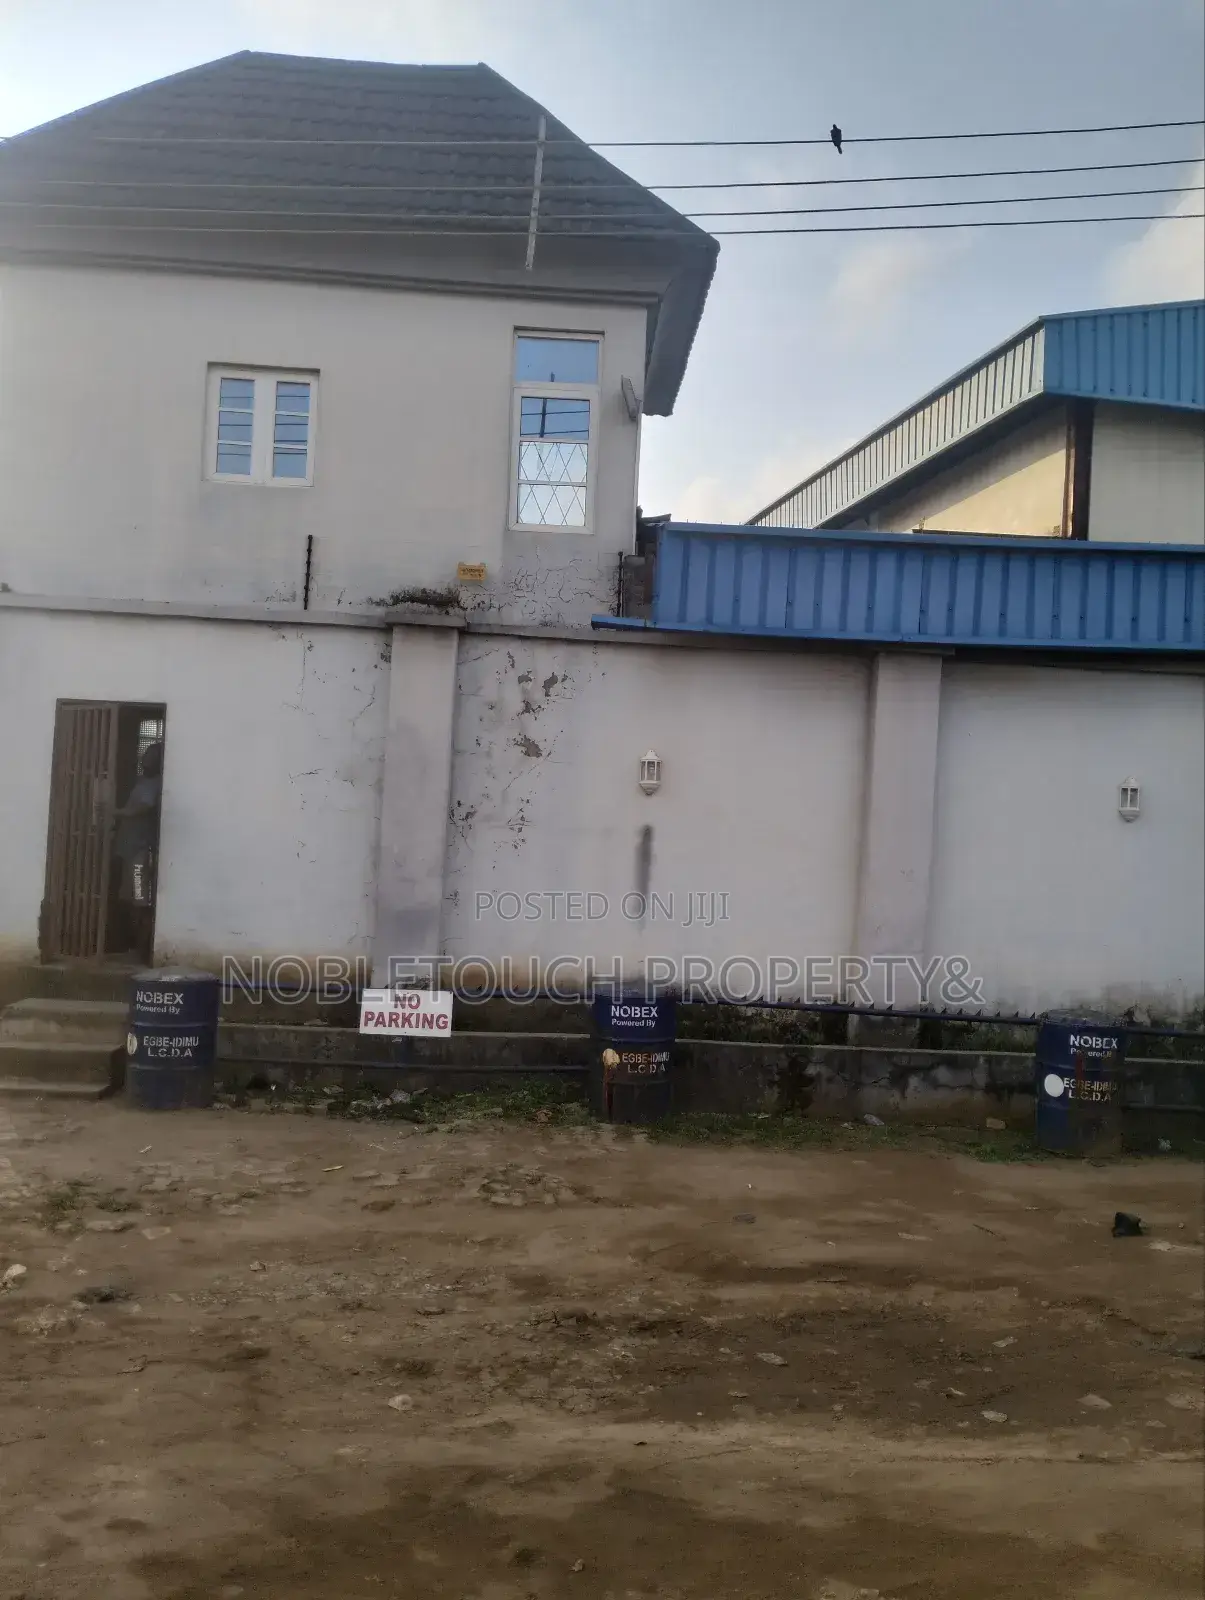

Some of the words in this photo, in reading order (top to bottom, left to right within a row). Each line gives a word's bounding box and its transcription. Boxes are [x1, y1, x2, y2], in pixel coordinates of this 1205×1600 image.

[136, 990, 184, 1005] NOBEX
[394, 993, 421, 1010] NO
[136, 1004, 167, 1013] Powered
[169, 1006, 180, 1014] By
[611, 1005, 658, 1018] NOBEX
[364, 1011, 449, 1030] PARKING
[611, 1018, 645, 1027] Powered
[646, 1019, 656, 1028] By
[1069, 1034, 1118, 1049] NOBEX
